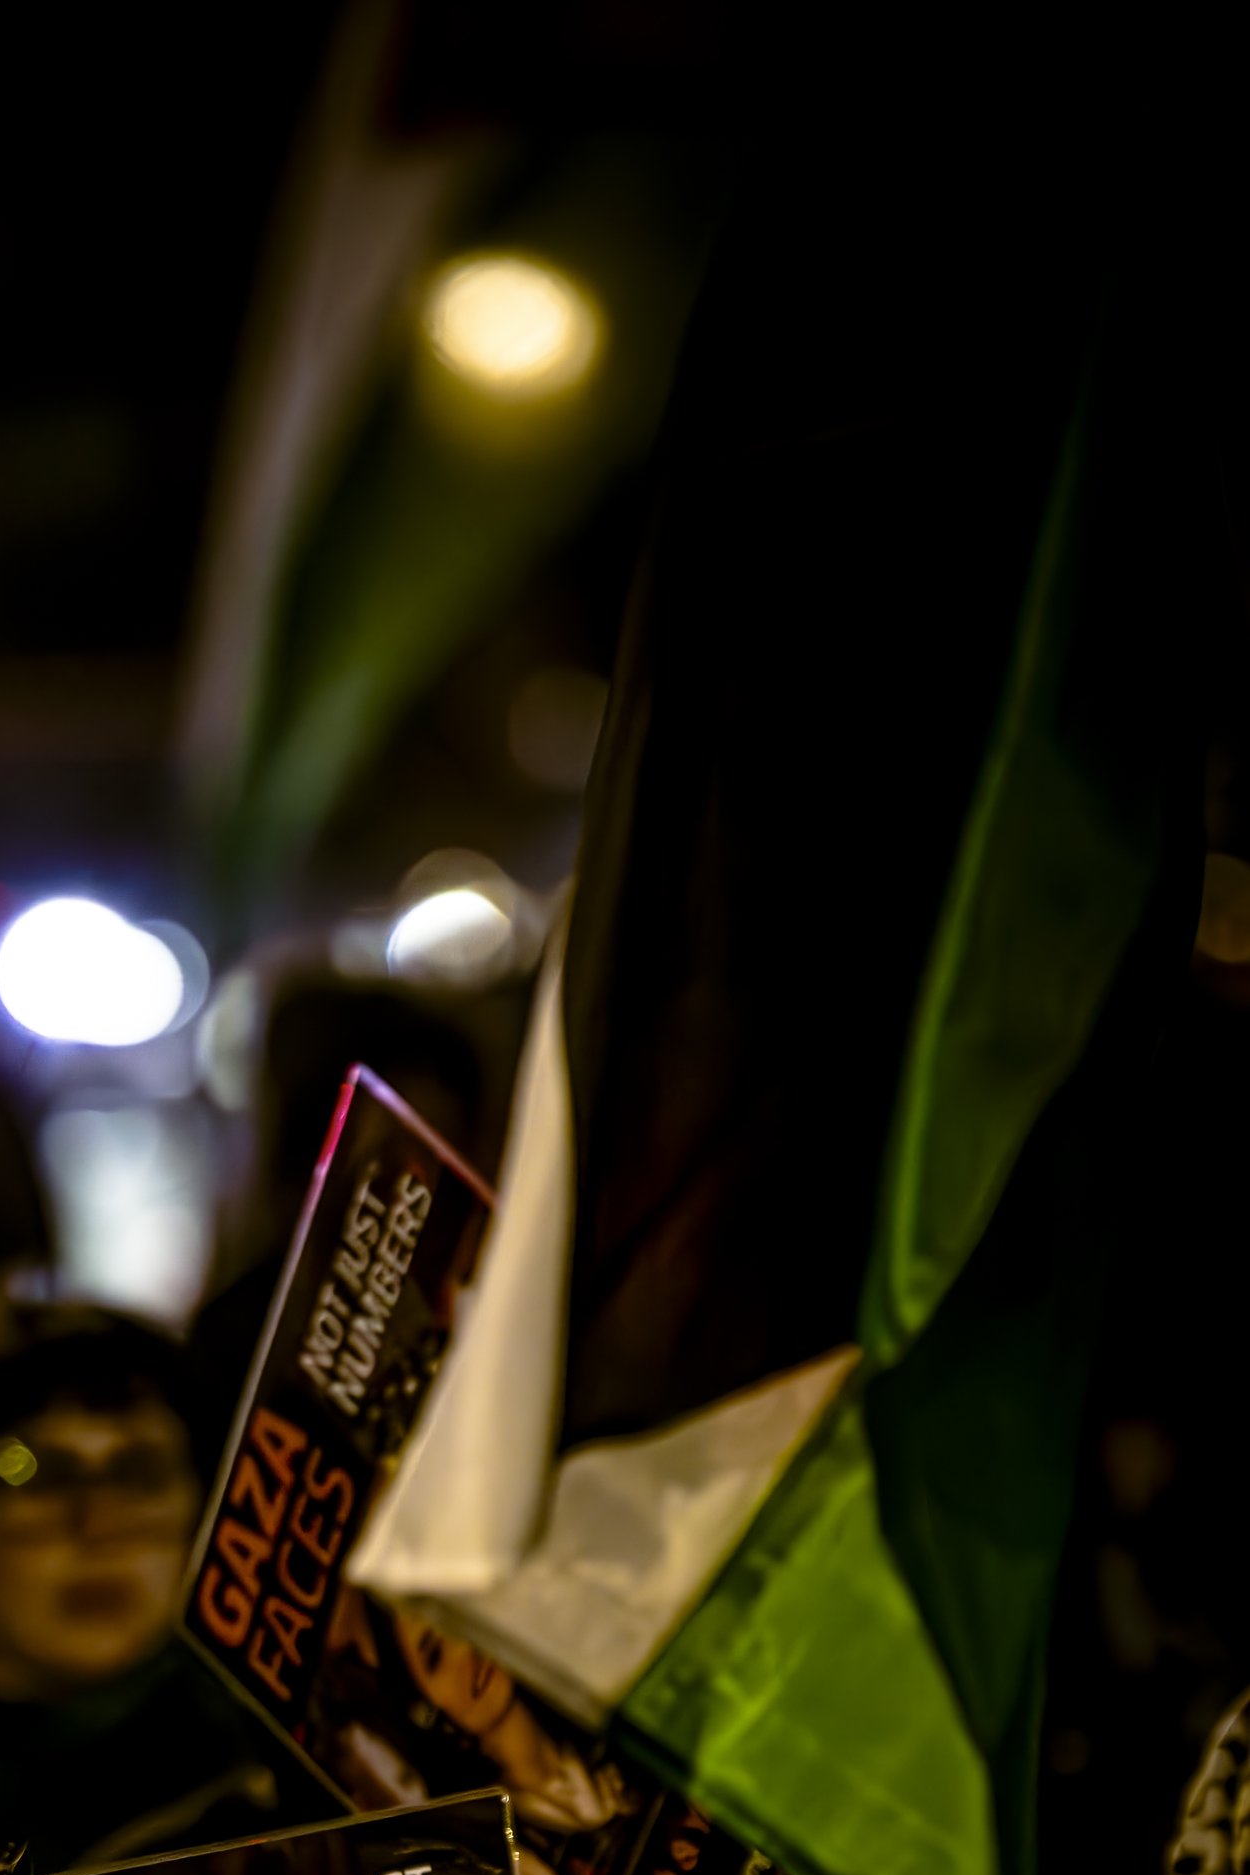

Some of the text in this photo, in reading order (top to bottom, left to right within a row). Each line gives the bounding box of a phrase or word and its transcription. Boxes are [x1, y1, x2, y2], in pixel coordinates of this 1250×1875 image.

[298, 1180, 387, 1391] NOT JUST
[197, 1406, 310, 1649] GAZA
[245, 1443, 357, 1704] FACES
